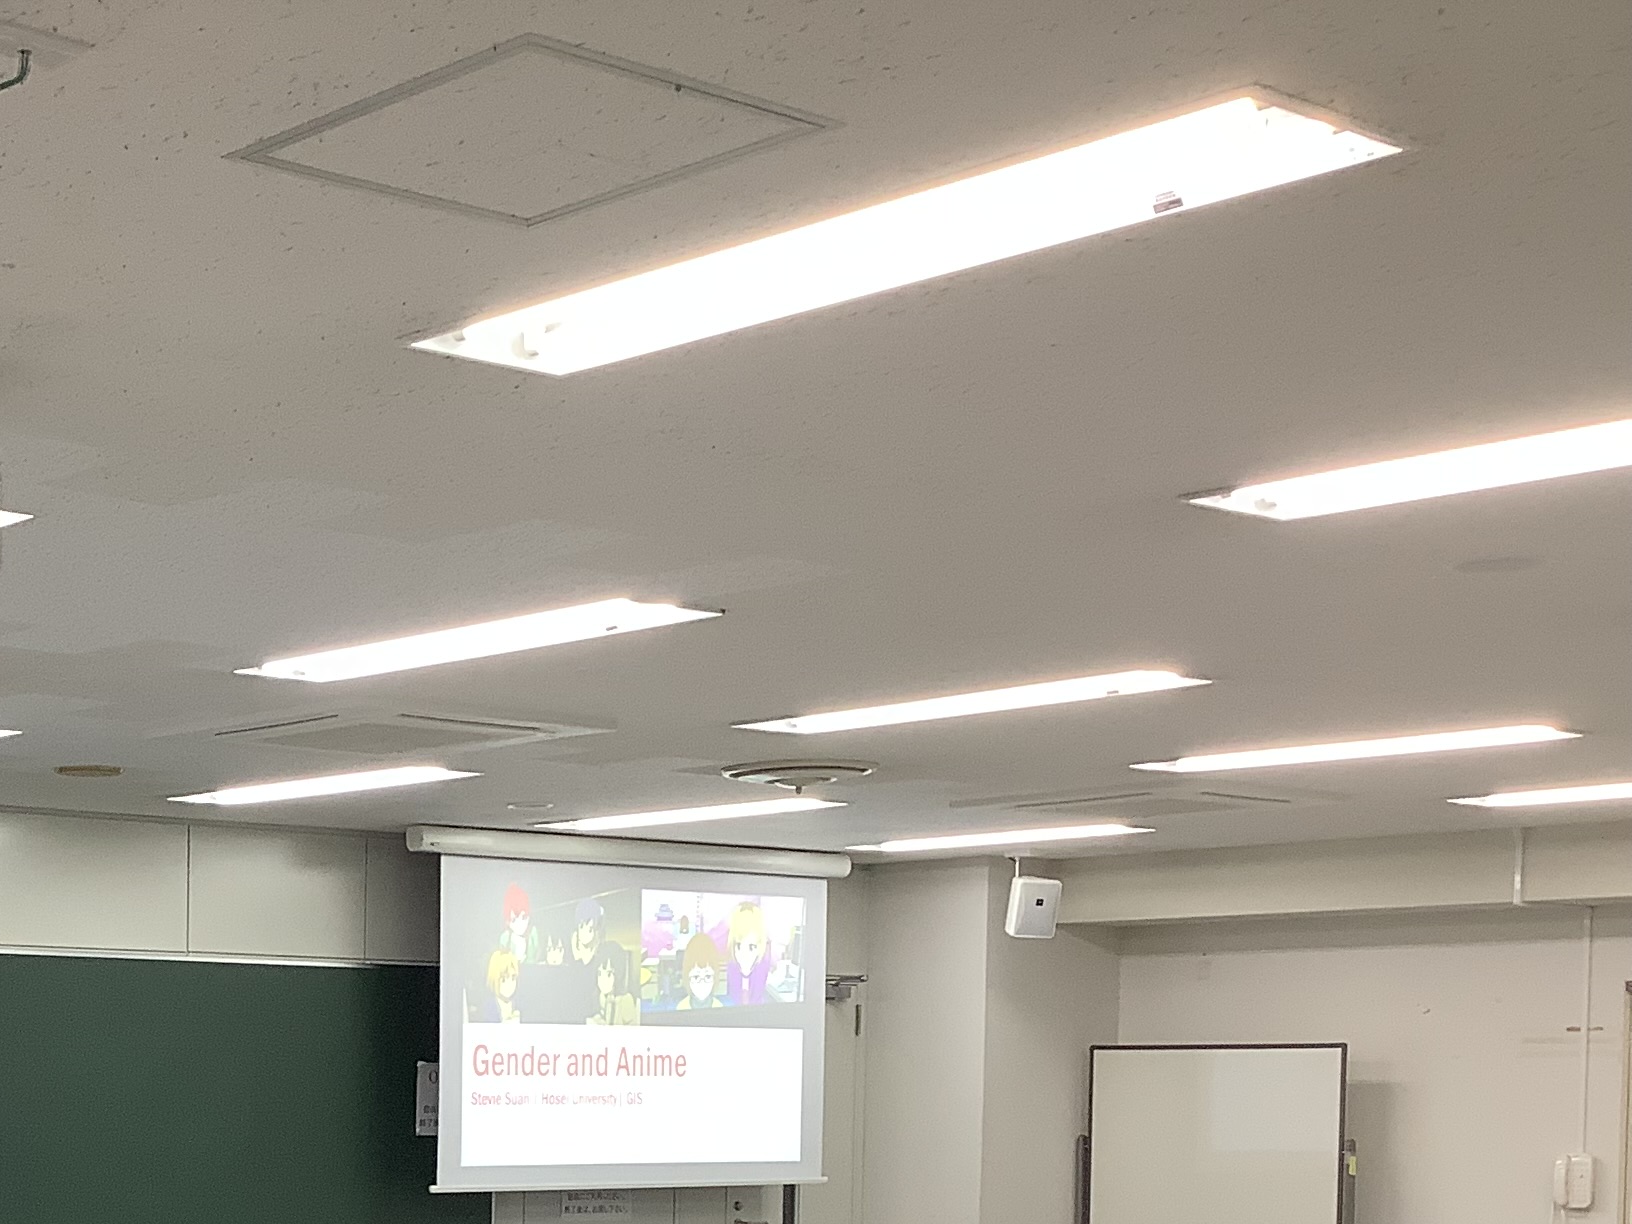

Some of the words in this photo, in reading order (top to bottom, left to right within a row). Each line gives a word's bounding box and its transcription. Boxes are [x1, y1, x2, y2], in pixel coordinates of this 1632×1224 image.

[472, 1043, 560, 1078] Gender
[566, 1046, 609, 1077] and
[616, 1046, 687, 1078] Anime
[505, 1092, 529, 1106] Suan
[626, 1092, 643, 1106] GIS
